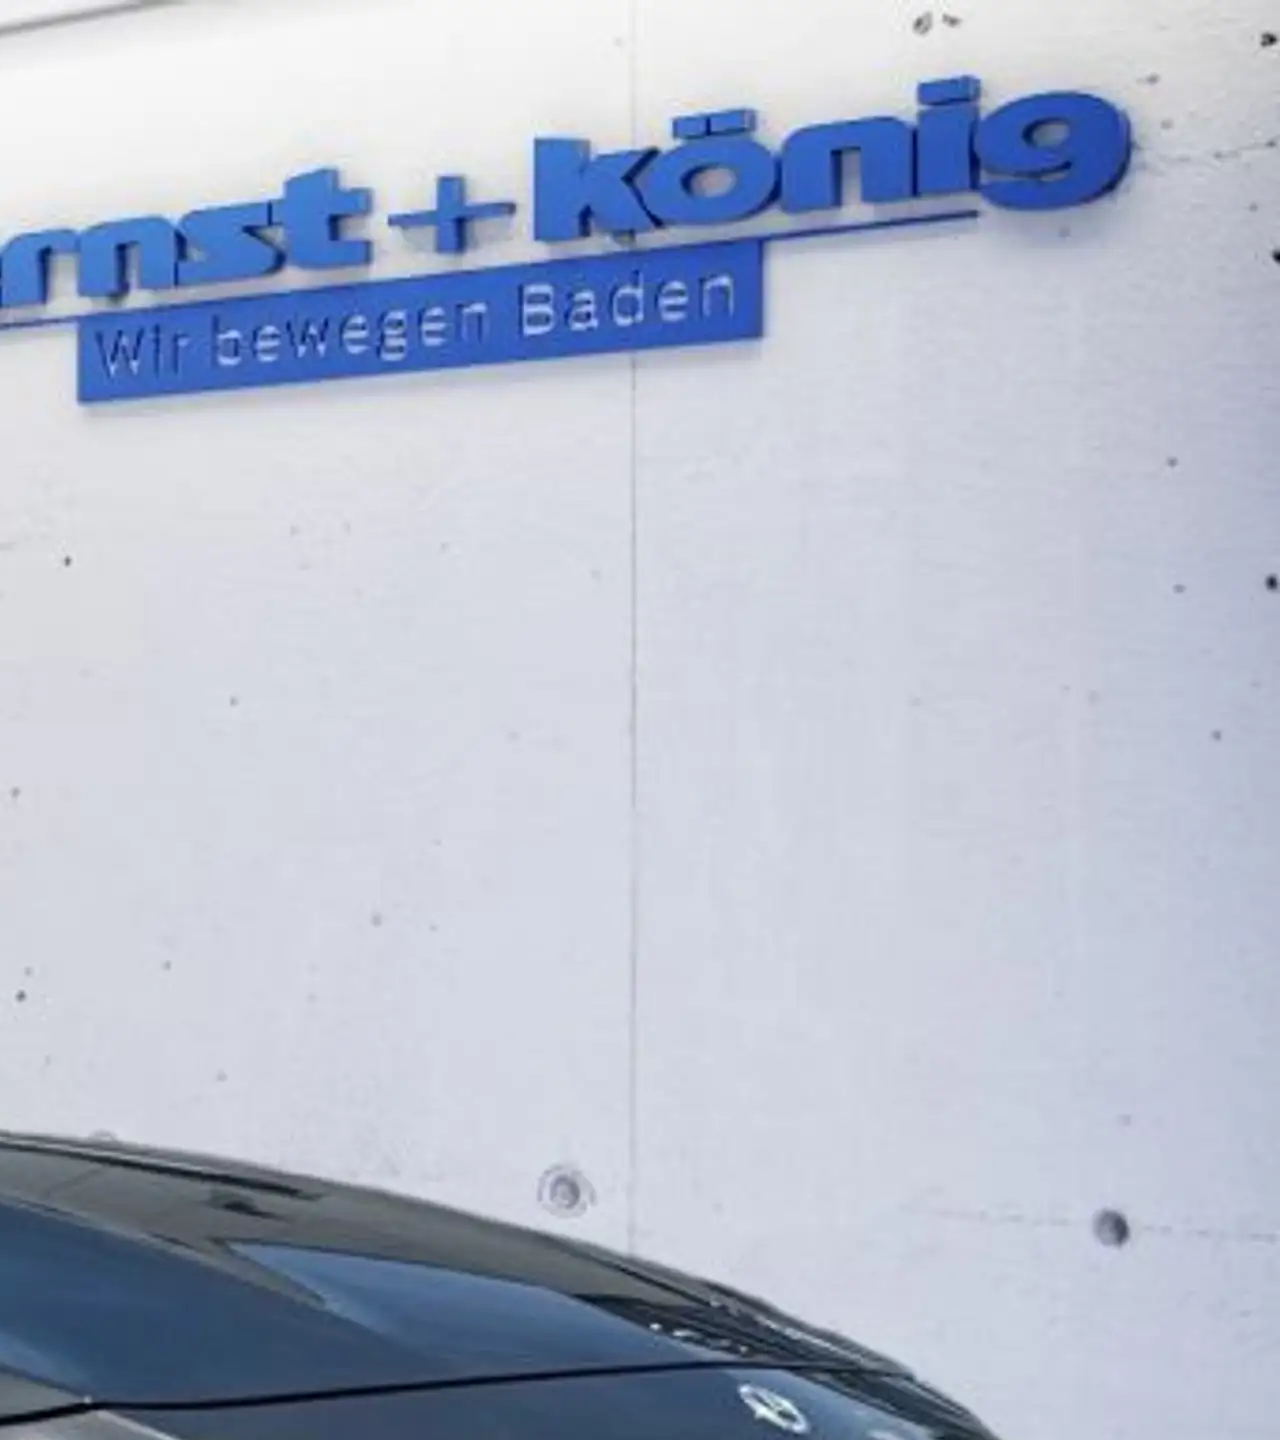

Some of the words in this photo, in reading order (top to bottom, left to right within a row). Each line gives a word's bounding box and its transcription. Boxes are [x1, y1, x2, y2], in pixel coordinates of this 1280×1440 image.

[387, 175, 517, 254] +
[533, 75, 1132, 243] könig
[96, 324, 189, 378] Wir
[211, 300, 489, 367] bewegen
[518, 270, 734, 337] Baden
